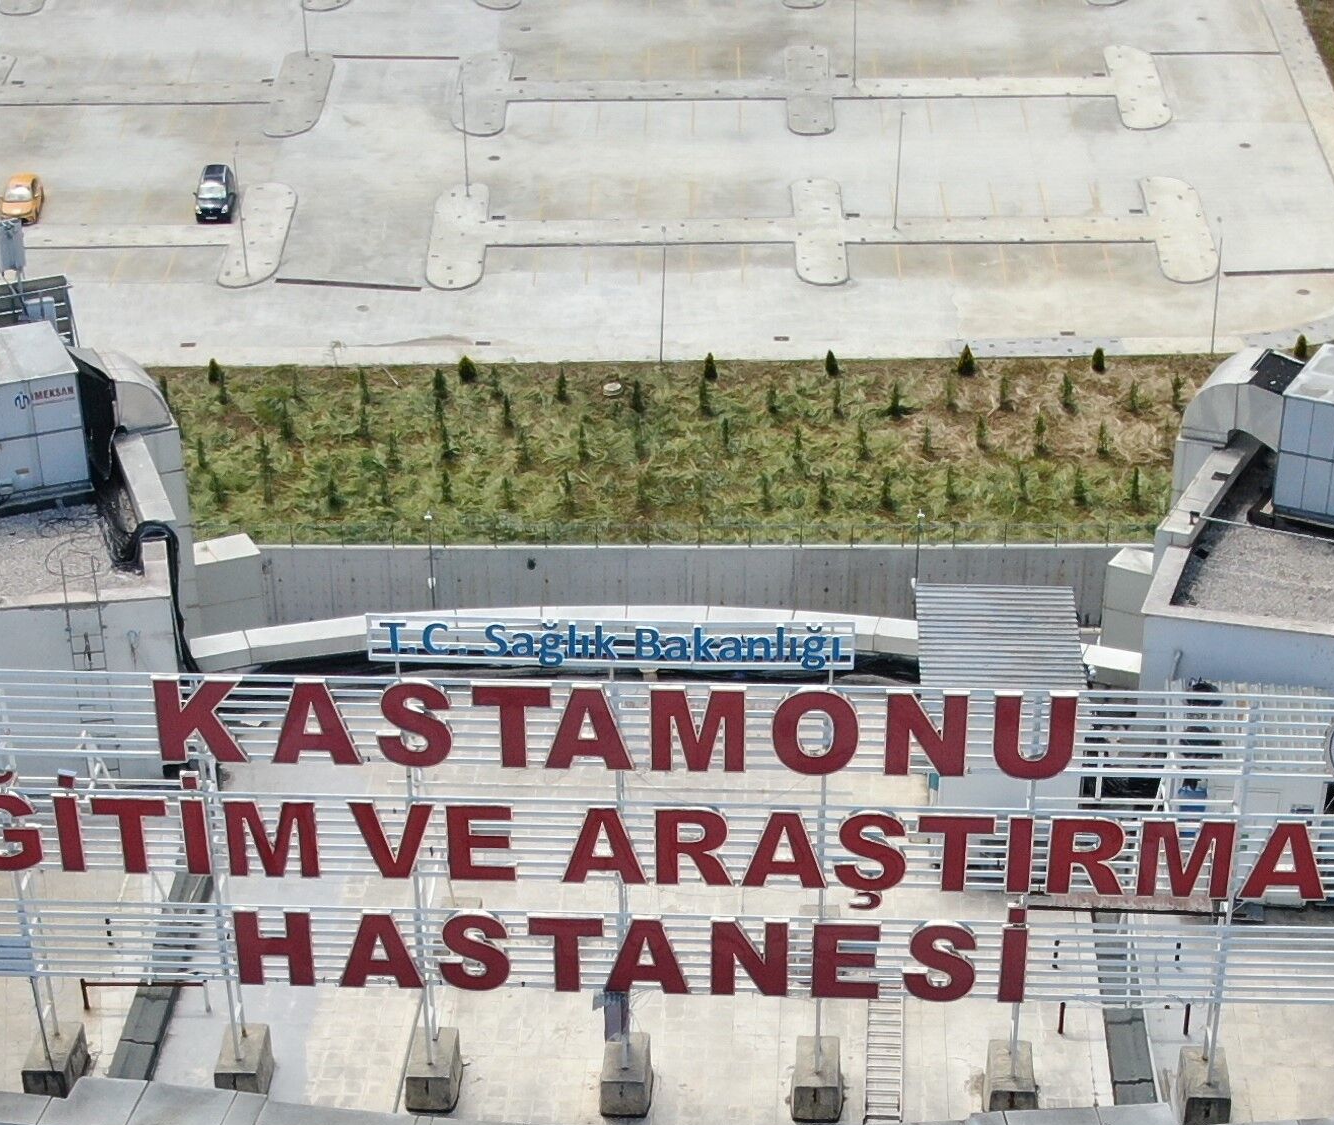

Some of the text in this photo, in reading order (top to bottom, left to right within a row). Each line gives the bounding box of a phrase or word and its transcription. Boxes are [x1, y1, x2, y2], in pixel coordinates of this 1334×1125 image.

[379, 618, 843, 671] T.C. Sağlık Bakanlığı
[150, 677, 1079, 780] KASTAMONU
[349, 801, 518, 882] VE
[562, 805, 1327, 909] ARAŞTIRMA
[234, 906, 1028, 1004] HASTANESİ
